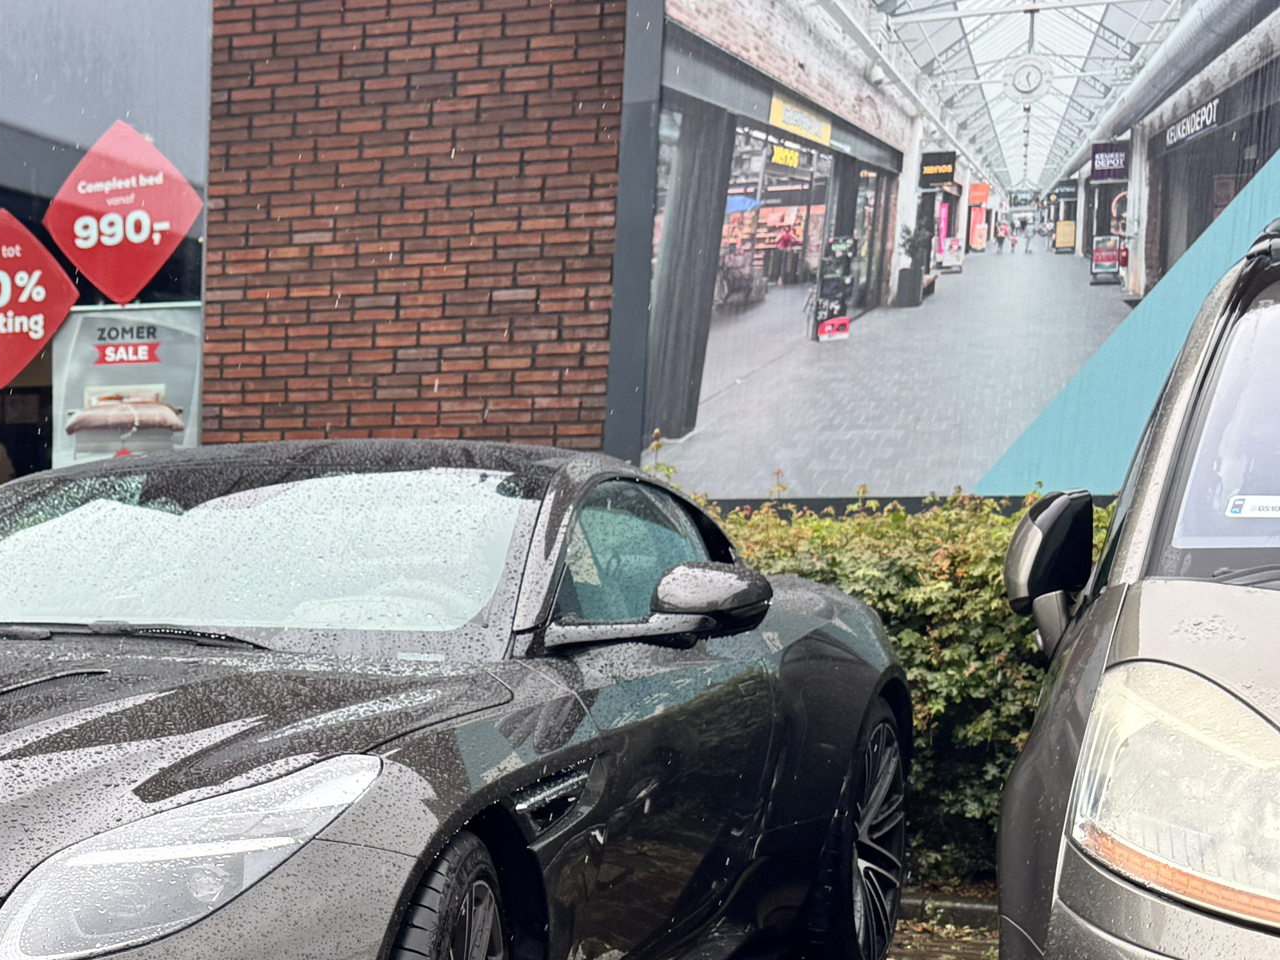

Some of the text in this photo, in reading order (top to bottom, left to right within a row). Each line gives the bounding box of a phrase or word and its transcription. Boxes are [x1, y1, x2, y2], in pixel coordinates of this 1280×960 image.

[1165, 97, 1220, 147] KEUKENDEPOT
[1094, 159, 1125, 168] DEPOT
[77, 171, 164, 196] Compleet bed
[106, 193, 135, 207] vanaf
[1, 244, 22, 259] tot
[97, 325, 158, 342] ZOMER
[104, 344, 150, 362] SALE
